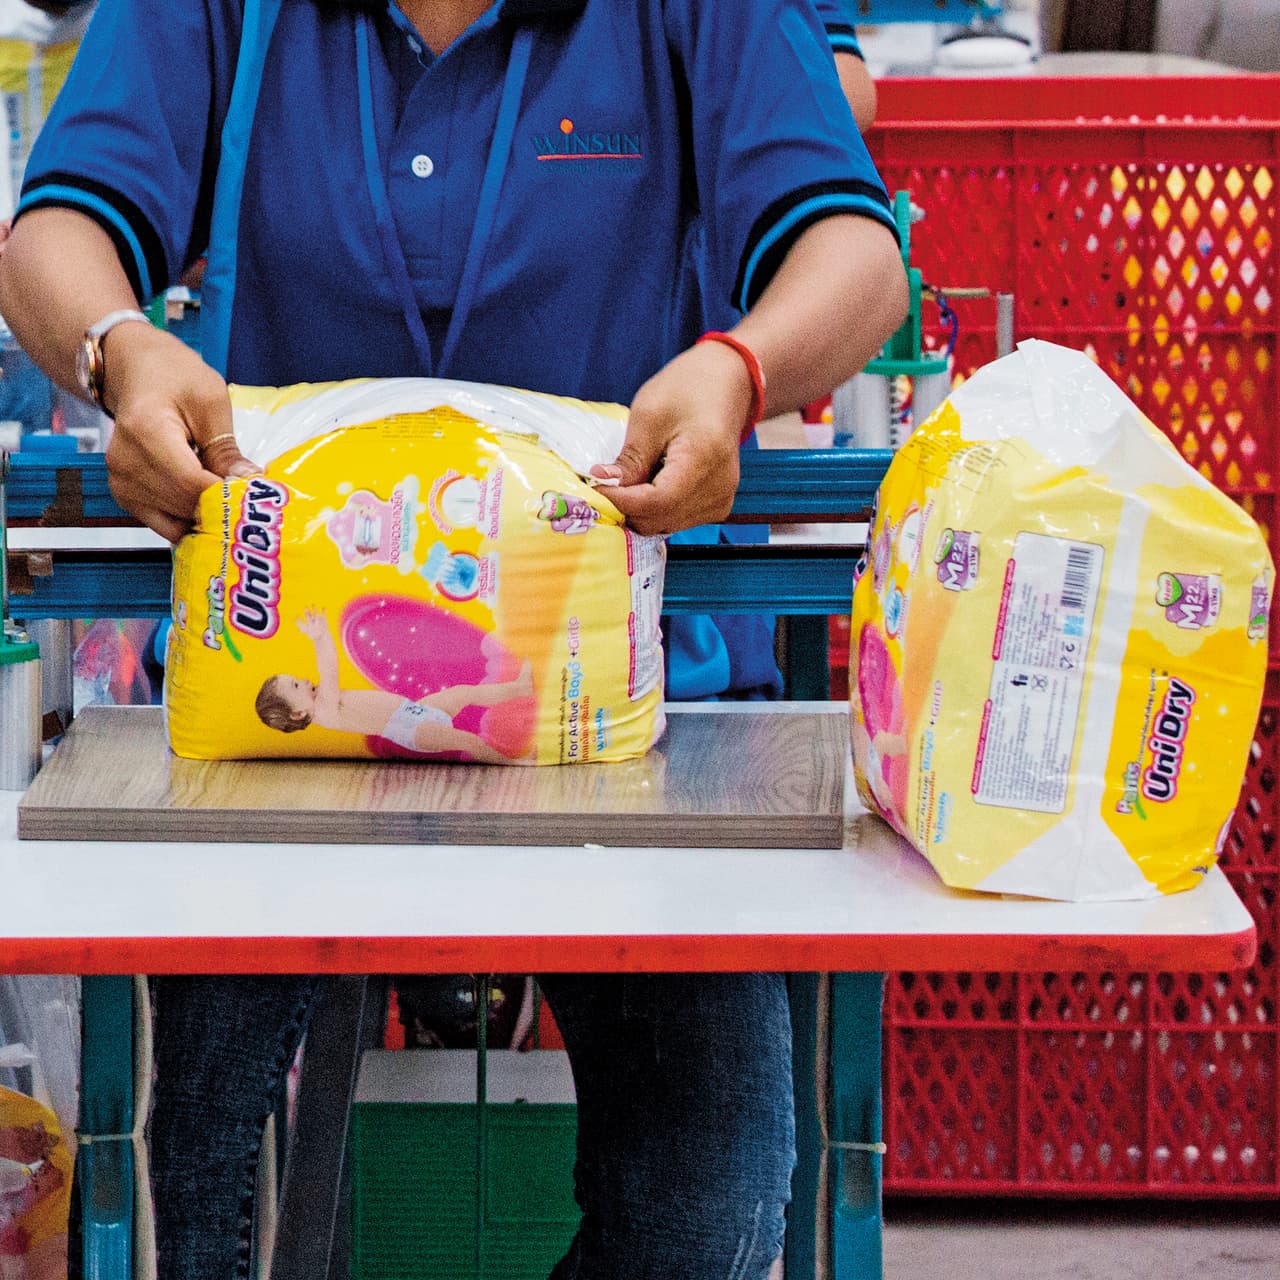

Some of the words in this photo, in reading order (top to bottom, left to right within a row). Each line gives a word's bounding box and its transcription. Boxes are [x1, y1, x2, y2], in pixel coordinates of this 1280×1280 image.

[1185, 585, 1200, 604] 22
[1176, 603, 1204, 629] M
[567, 701, 579, 736] Active
[567, 737, 579, 757] For
